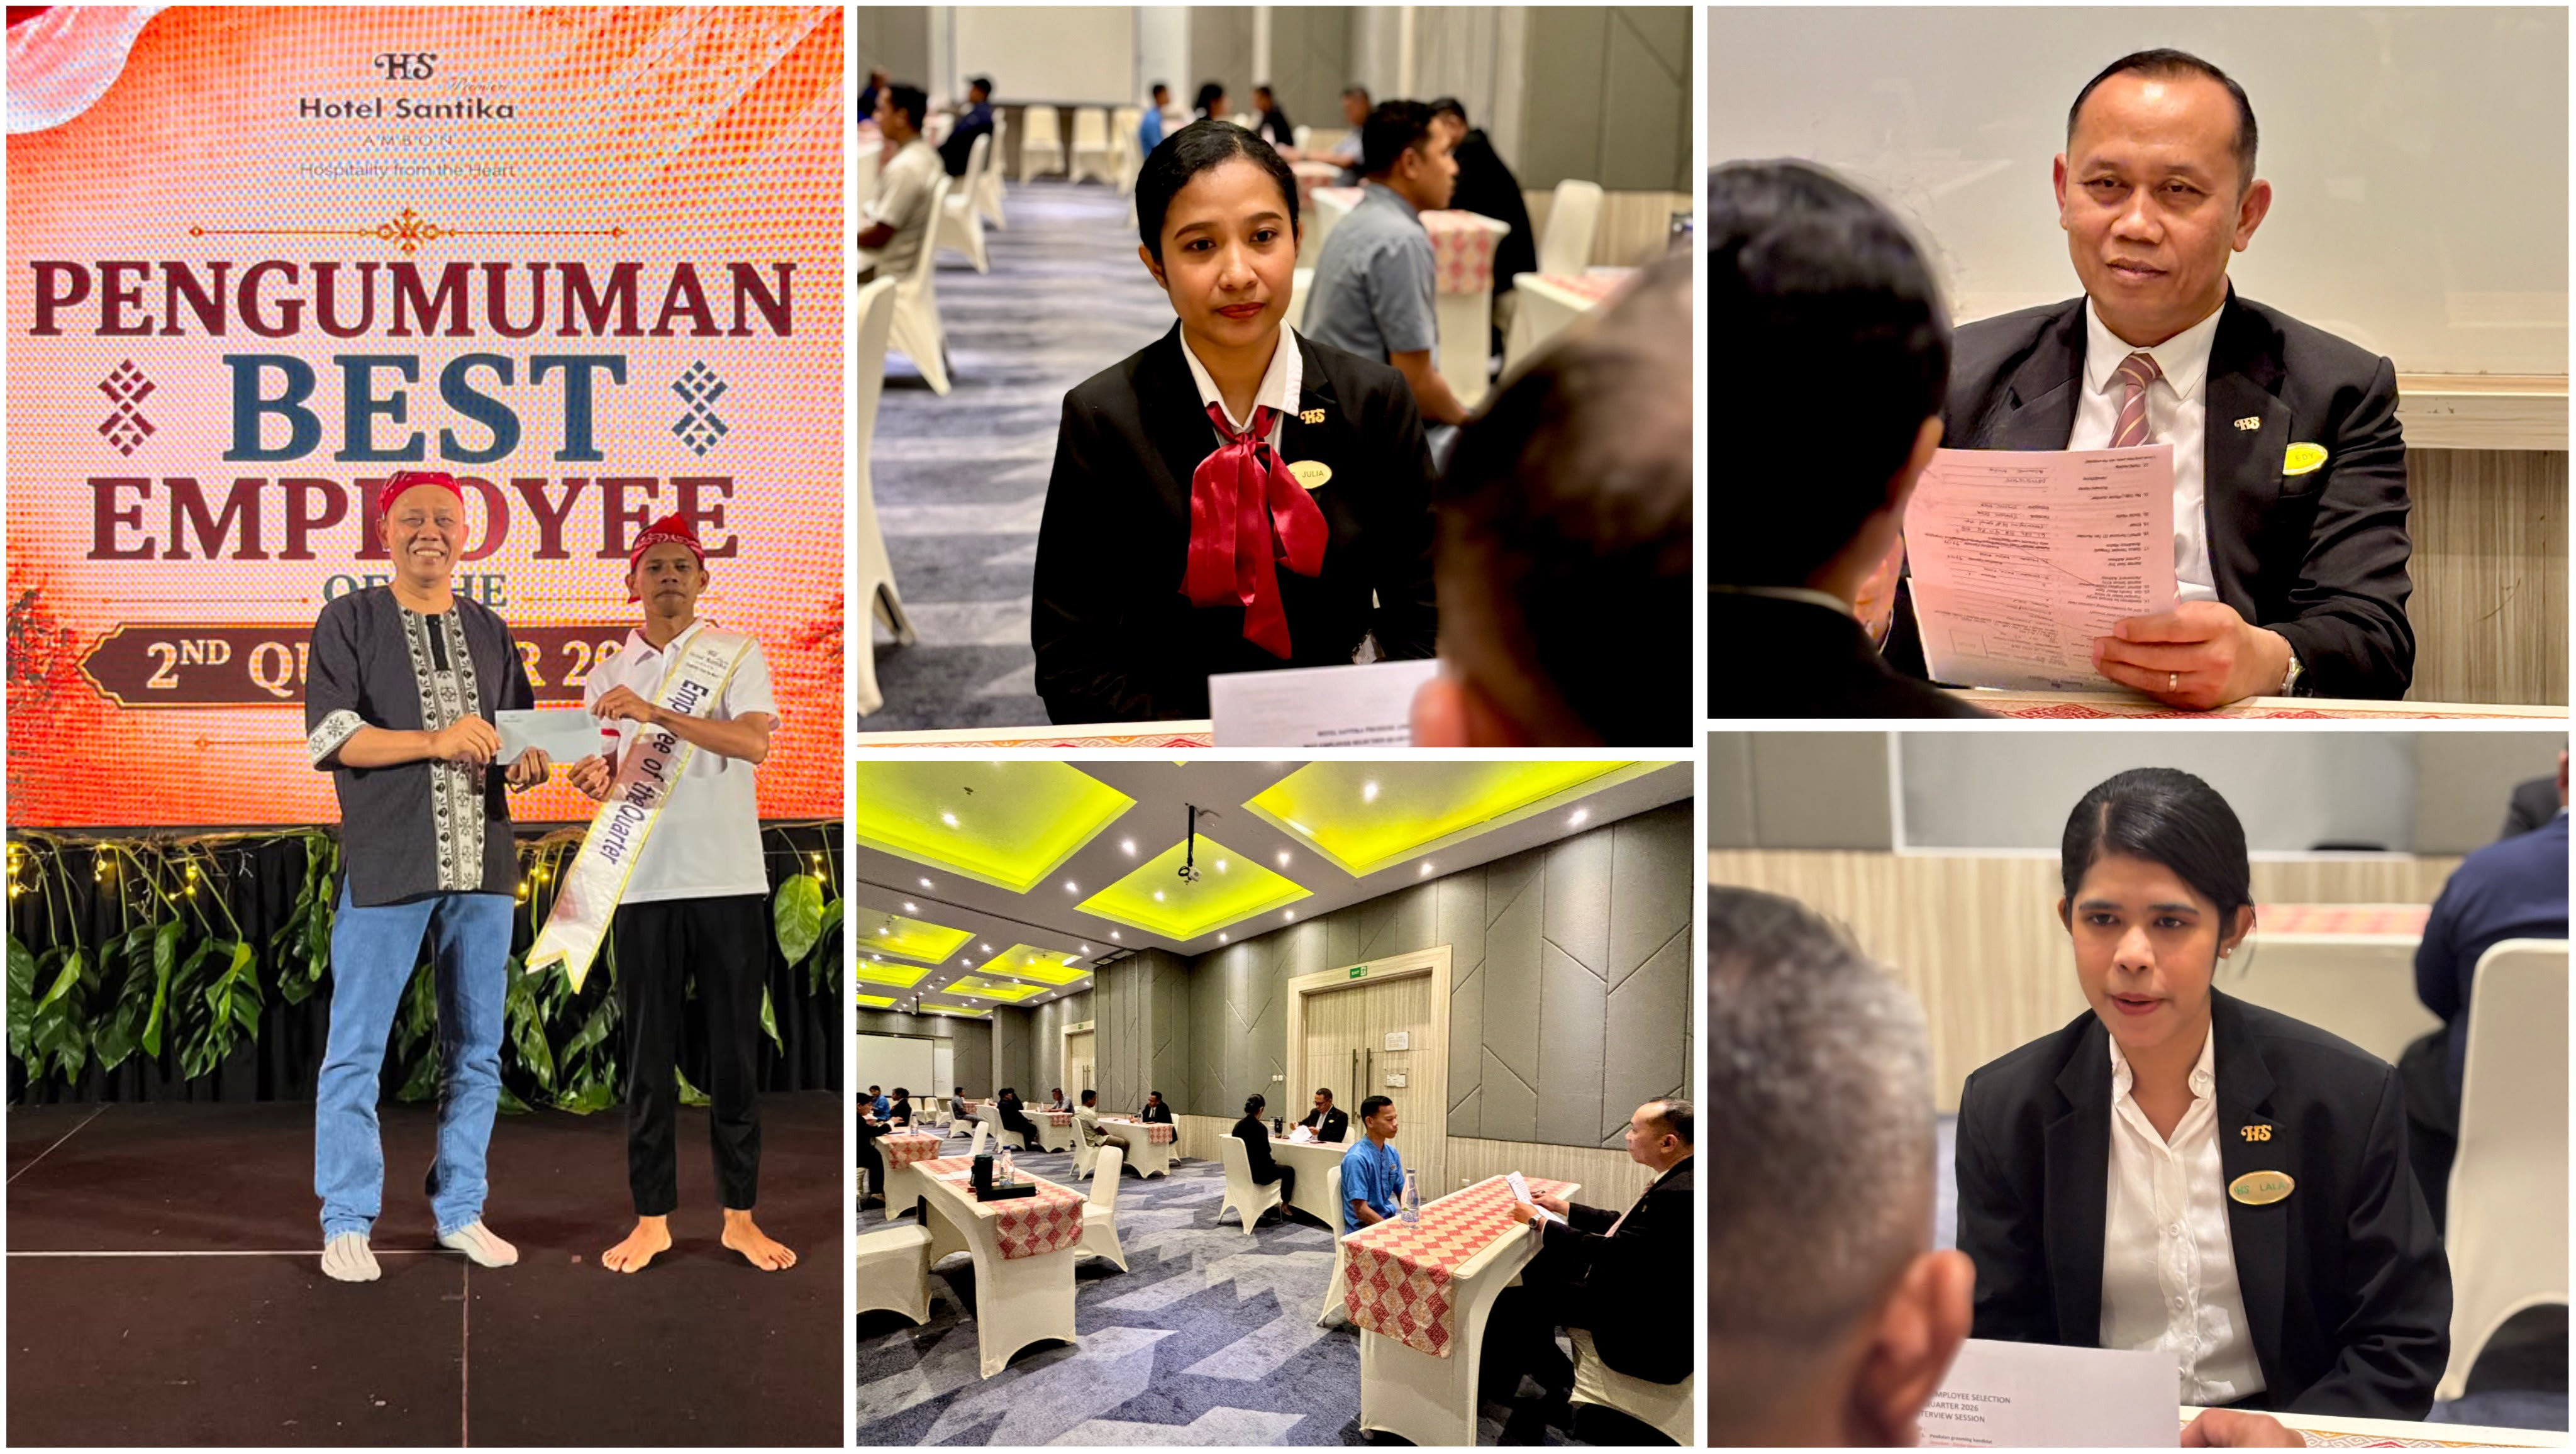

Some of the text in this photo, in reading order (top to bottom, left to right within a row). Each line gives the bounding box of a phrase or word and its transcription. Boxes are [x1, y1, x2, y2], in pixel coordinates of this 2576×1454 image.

[374, 52, 438, 80] HS
[300, 97, 514, 119] Hotel Santika
[362, 134, 453, 147] AMBON
[300, 163, 515, 180] Hospitality from the Heart
[28, 259, 798, 340] PENGUMUMAN
[221, 352, 628, 464] BEST
[1300, 408, 1326, 425] HS
[1301, 470, 1324, 478] JULIA
[641, 757, 664, 784] of
[2240, 1124, 2272, 1142] HS
[2260, 1181, 2285, 1192] LALA
[1934, 1391, 2011, 1404] MPLOYEE SELECTION
[1961, 1403, 1979, 1411] 2026
[1920, 1411, 1985, 1423] TERVIEW SESSION
